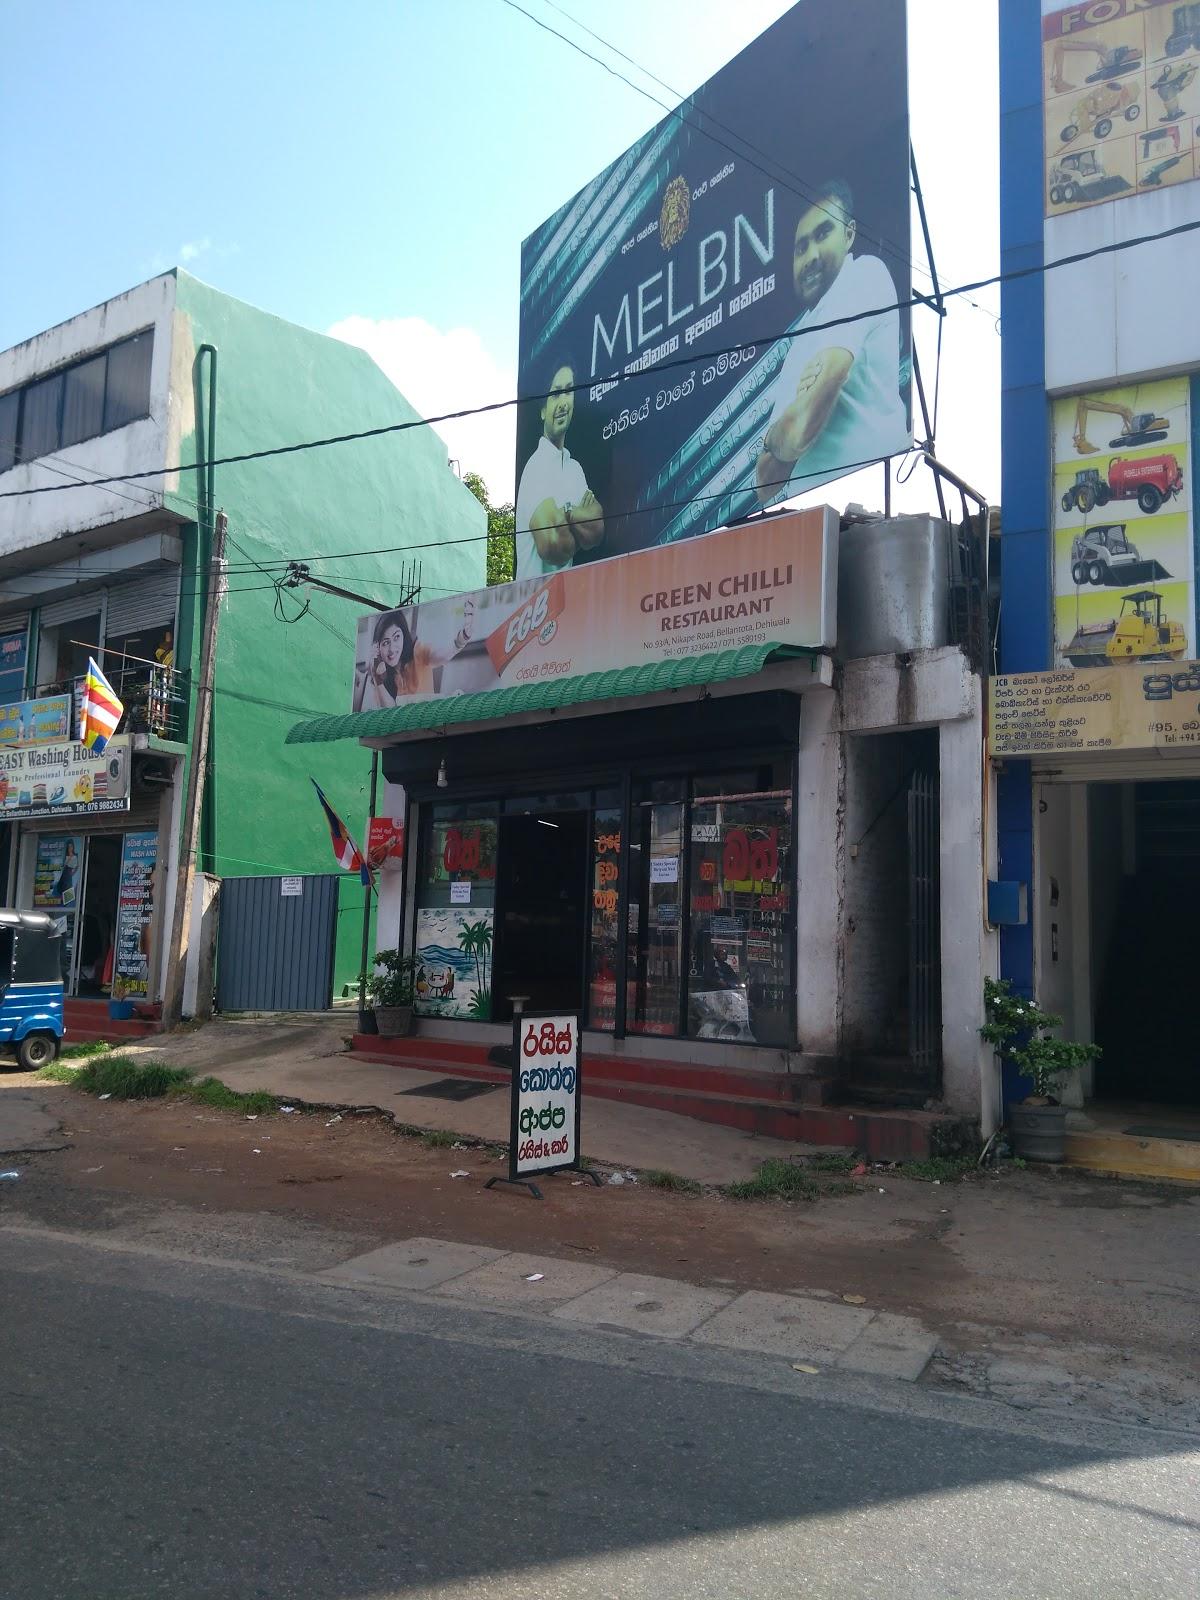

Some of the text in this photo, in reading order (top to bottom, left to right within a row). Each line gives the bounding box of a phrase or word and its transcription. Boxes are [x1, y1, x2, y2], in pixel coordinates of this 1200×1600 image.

[590, 187, 775, 378] MELBN
[655, 370, 697, 411] වානේ
[640, 564, 793, 614] GREEN CHILLI
[660, 597, 774, 632] RESTAURANT
[755, 617, 790, 630] Dehiwala
[995, 678, 1008, 687] JCB
[1164, 734, 1178, 743] Tel:
[1178, 733, 1195, 742] +94
[28, 746, 71, 768] Washing
[24, 769, 62, 781] Professional
[63, 767, 91, 777] Laundry
[76, 803, 88, 812] Tel:
[87, 802, 99, 811] 076
[145, 849, 157, 857] AND
[519, 1061, 577, 1095] කොත්තු
[519, 1100, 566, 1137] ආප්ප
